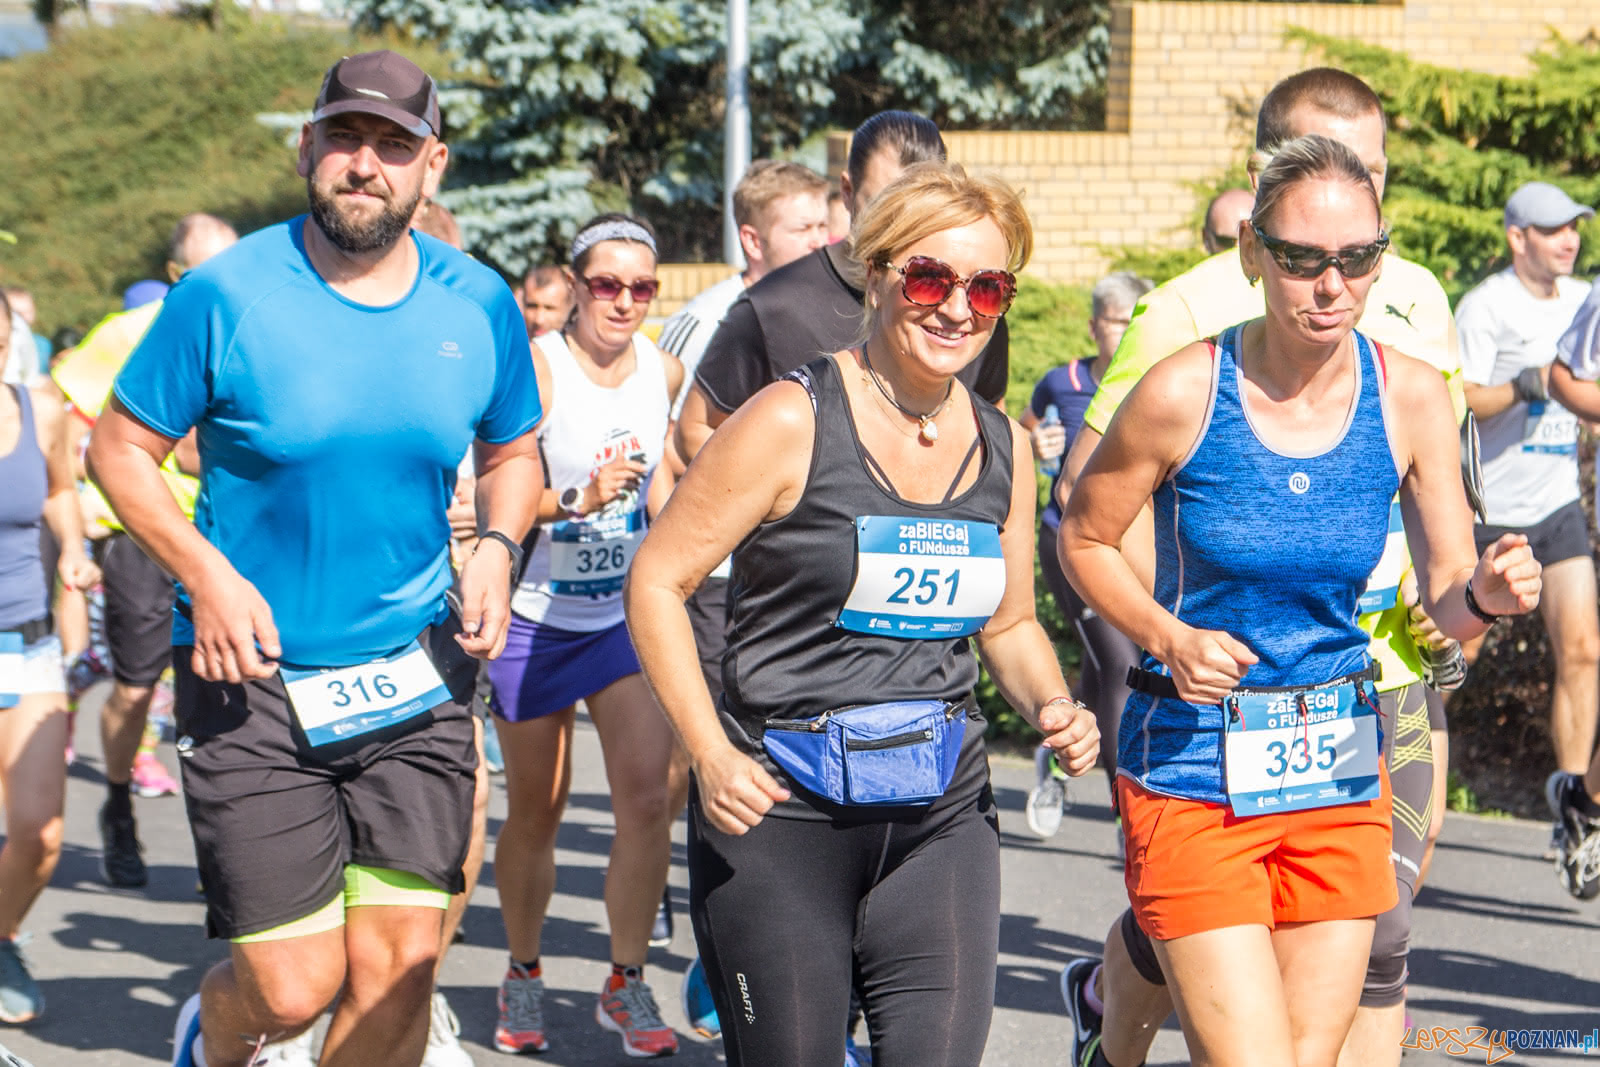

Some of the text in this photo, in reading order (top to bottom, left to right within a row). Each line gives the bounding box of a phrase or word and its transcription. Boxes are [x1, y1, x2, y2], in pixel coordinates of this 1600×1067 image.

[899, 522, 969, 545] zaBIEGaj
[899, 541, 970, 556] o FUNdusze
[576, 545, 625, 574] 326
[886, 567, 960, 606] 251
[327, 674, 398, 707] 316
[1268, 718, 1277, 728] o
[1265, 733, 1337, 777] 335
[736, 972, 754, 1015] CRAFT
